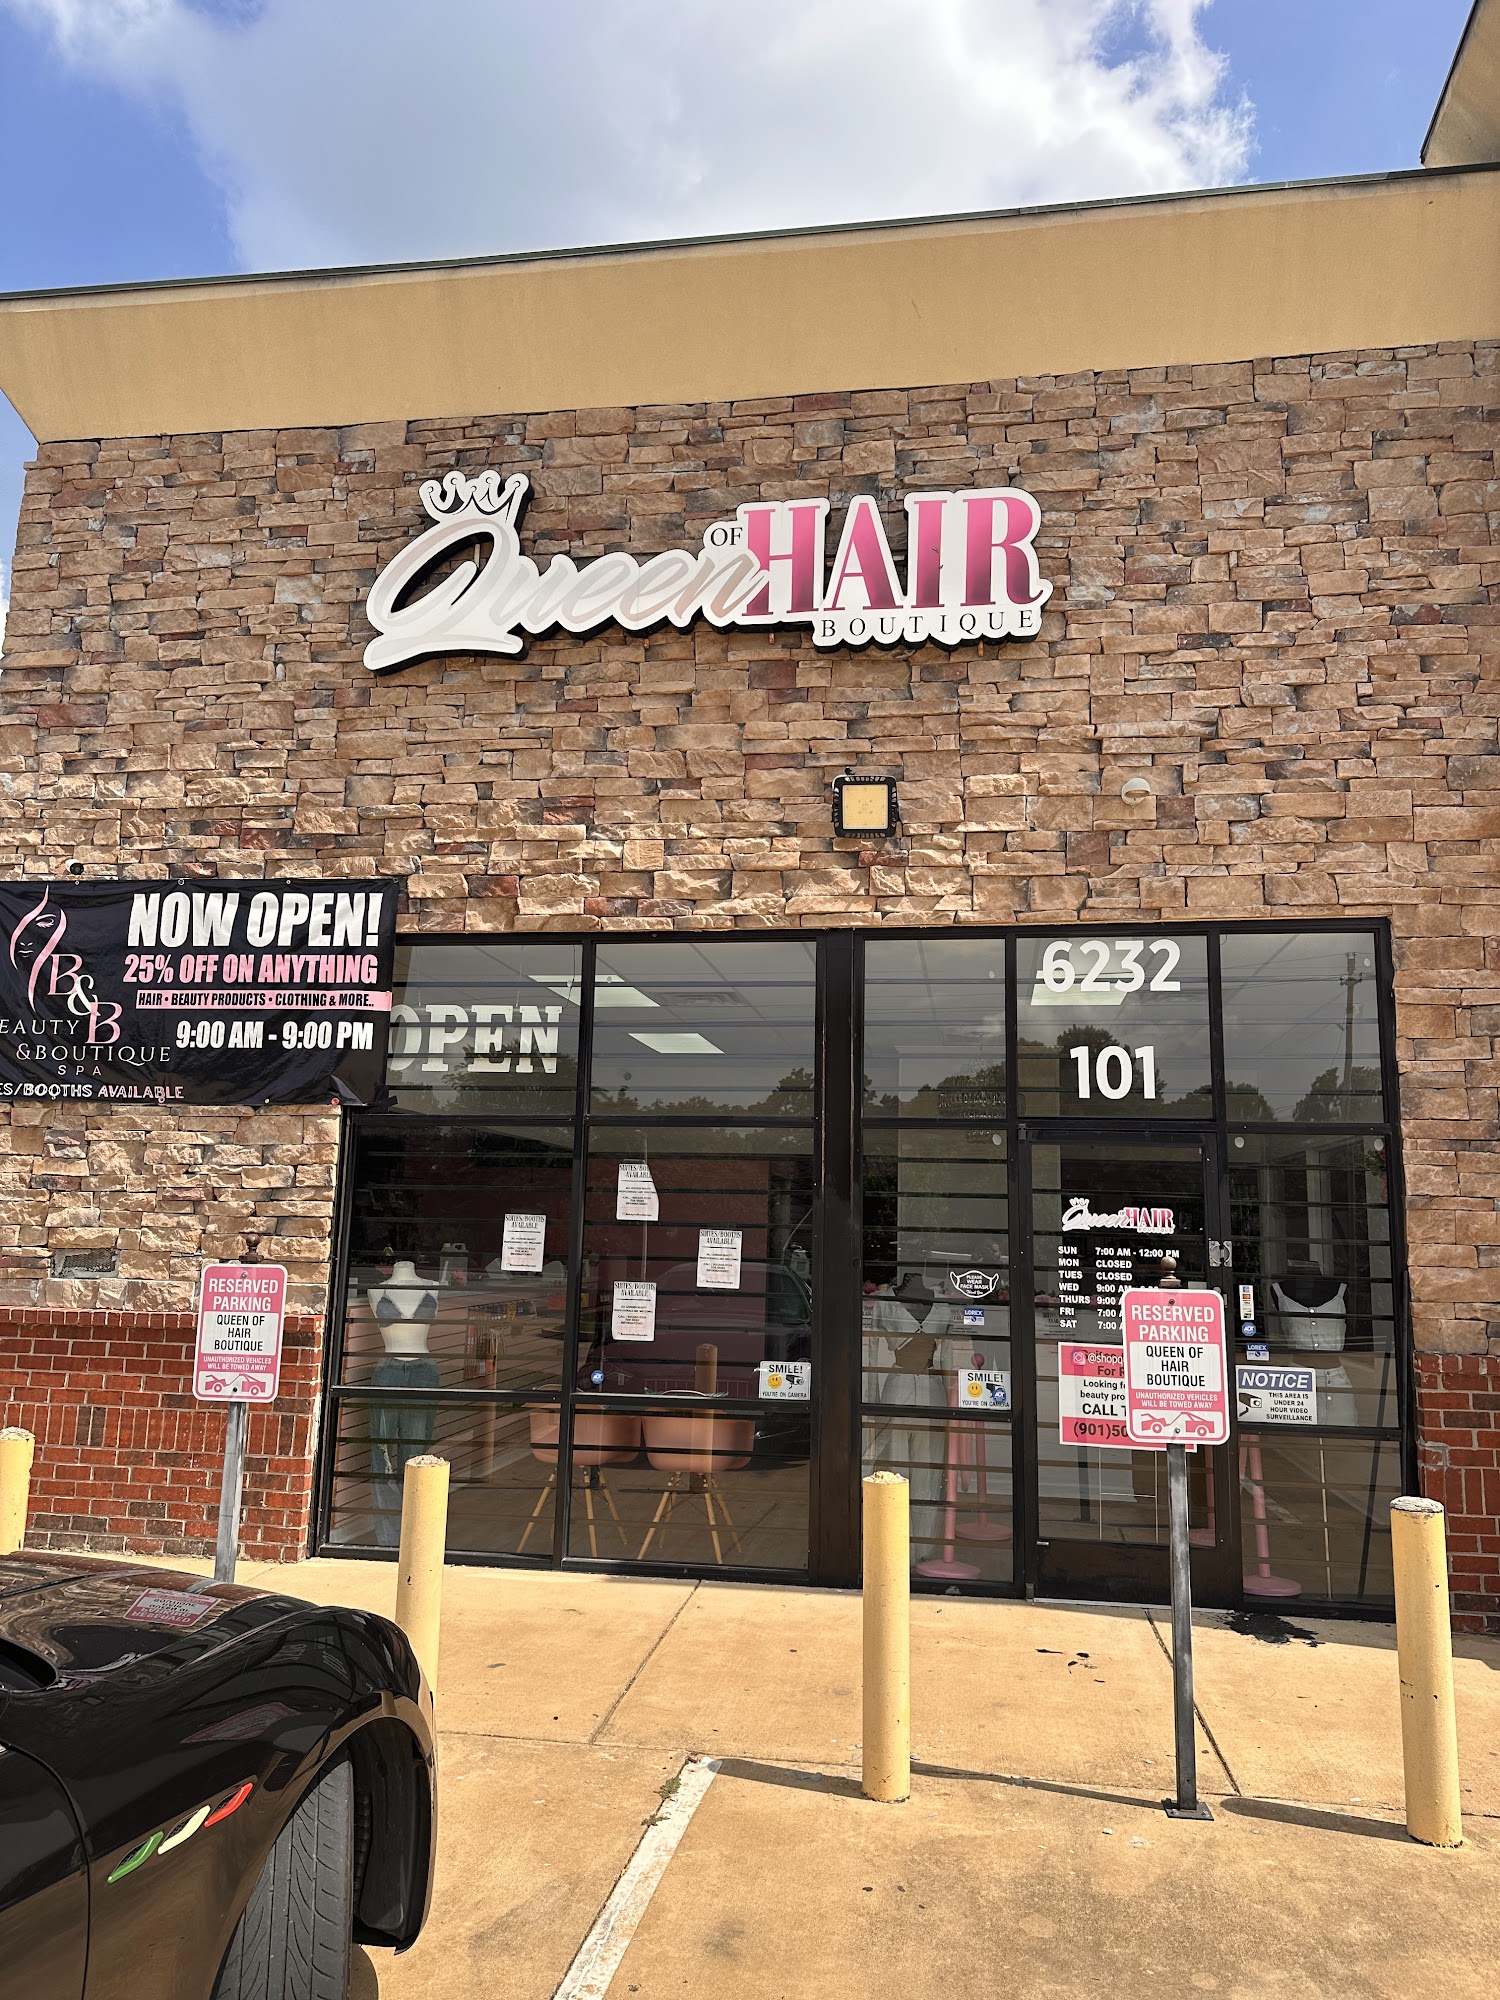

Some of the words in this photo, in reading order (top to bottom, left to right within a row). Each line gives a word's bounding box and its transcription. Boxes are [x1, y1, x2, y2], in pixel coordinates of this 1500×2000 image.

[710, 527, 743, 547] OF
[741, 496, 1044, 617] HAIR
[366, 512, 768, 668] Queen
[820, 609, 1034, 640] BOUTIQUE
[127, 891, 240, 948] NOW
[246, 891, 384, 948] OPEN!
[122, 953, 175, 984] 25%
[178, 953, 219, 984] OFF
[222, 953, 255, 984] ON
[257, 953, 379, 985] ANYTHING
[1042, 938, 1181, 993] 6232
[137, 992, 163, 1006] HAIR
[171, 992, 209, 1006] BEAUTY
[211, 992, 266, 1007] PRODUCTS
[275, 992, 327, 1008] CLOTHING
[328, 995, 337, 1007] &
[175, 1020, 226, 1049] 9:00
[227, 1020, 264, 1049] AM
[281, 1020, 332, 1050] 9:00
[336, 1021, 374, 1050] PM
[387, 1004, 562, 1074] OPEN
[57, 1065, 102, 1076] SPA
[1070, 1045, 1156, 1100] 101
[98, 1085, 184, 1099] AVAILABLE
[1062, 1205, 1130, 1231] Queen
[1125, 1208, 1175, 1228] HAIR
[1058, 1246, 1077, 1255] SUN
[1095, 1247, 1115, 1256] 7:00
[1116, 1248, 1131, 1257] AM
[1139, 1248, 1163, 1258] 12:00
[1166, 1250, 1179, 1258] PM
[1058, 1258, 1079, 1267] MON
[1096, 1260, 1132, 1269] CLOSED
[1059, 1271, 1083, 1279] TUES
[1096, 1272, 1132, 1281] CLOSED
[208, 1278, 279, 1294] RESERVED
[1059, 1283, 1079, 1291] WED
[1096, 1284, 1116, 1293] 9:00
[213, 1296, 271, 1311] PARKING
[1059, 1295, 1091, 1304] THURS
[1096, 1296, 1116, 1305] 9:00
[1060, 1307, 1074, 1316] FRI
[1097, 1309, 1116, 1318] 7:00
[1131, 1304, 1215, 1323] RESERVED
[216, 1314, 249, 1326] QUEEN
[252, 1315, 265, 1326] OF
[1060, 1319, 1077, 1328] SAT
[1098, 1321, 1117, 1330] 7:00
[227, 1327, 251, 1338] HAIR
[1139, 1324, 1209, 1342] PARKING
[214, 1339, 263, 1351] BOUTIQUE
[1146, 1345, 1185, 1358] QUEEN
[1188, 1346, 1204, 1359] OF
[768, 1364, 803, 1373] SMILE!
[1097, 1365, 1116, 1376] For
[1161, 1360, 1189, 1372] HAIR
[967, 1373, 1003, 1382] SMILE!
[1147, 1373, 1206, 1387] BOUTIQUE
[1241, 1371, 1310, 1389] NOTICE
[1083, 1379, 1118, 1391] Looking
[1080, 1390, 1109, 1401] beauty
[1135, 1391, 1185, 1401] UNAUTHORIZED
[1186, 1393, 1218, 1402] VEHICLES
[1082, 1402, 1118, 1416] CALL
[1141, 1399, 1158, 1407] WILL
[1159, 1400, 1168, 1408] BE
[1169, 1400, 1193, 1409] TOWED
[1194, 1401, 1213, 1409] AWAY
[1266, 1413, 1312, 1421] SURVEILLANCE
